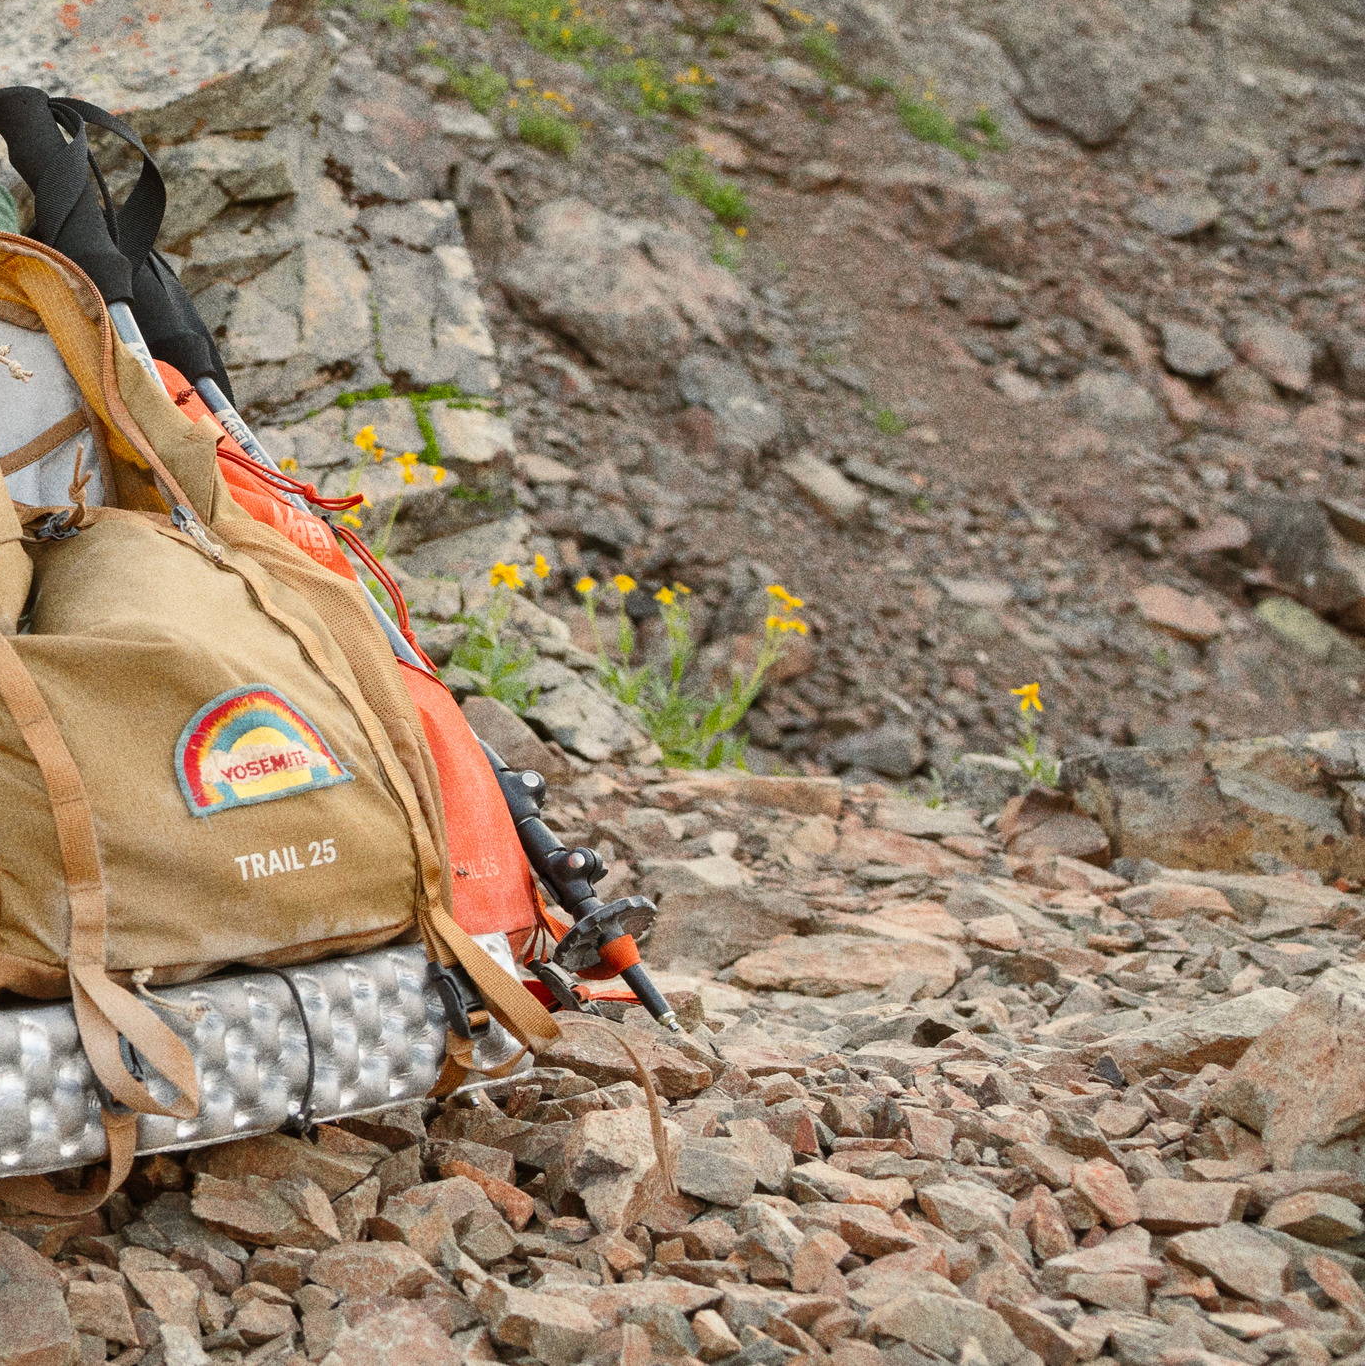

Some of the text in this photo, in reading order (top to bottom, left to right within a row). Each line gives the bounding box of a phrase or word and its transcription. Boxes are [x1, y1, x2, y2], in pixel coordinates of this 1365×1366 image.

[223, 418, 249, 446] REI
[291, 520, 330, 549] REI
[220, 751, 308, 782] YOSEMITE
[234, 838, 336, 880] TRAIL 25
[450, 856, 500, 882] RAIL 25
